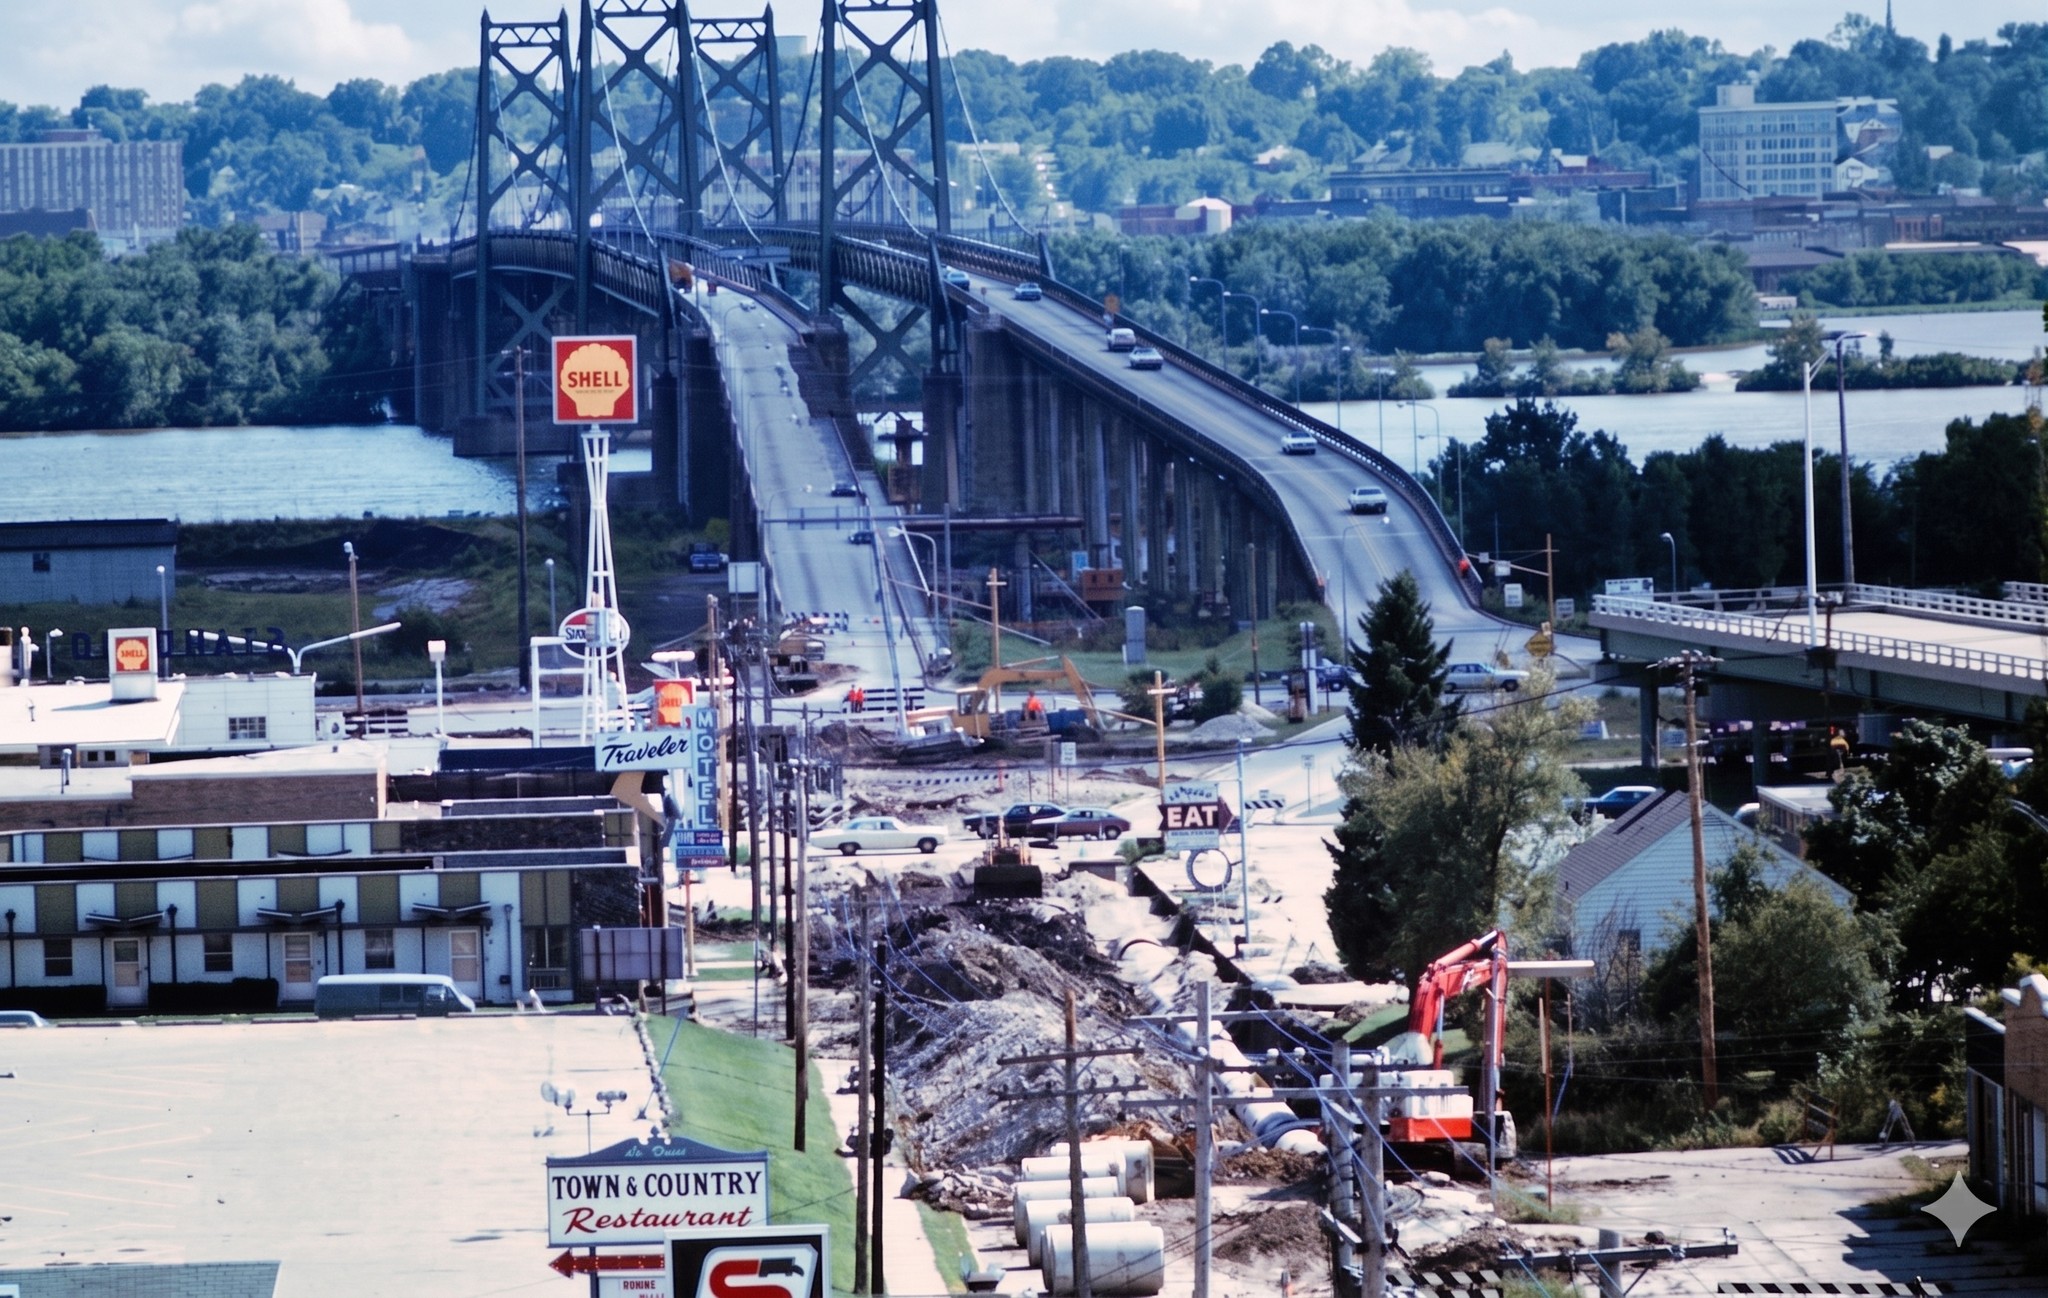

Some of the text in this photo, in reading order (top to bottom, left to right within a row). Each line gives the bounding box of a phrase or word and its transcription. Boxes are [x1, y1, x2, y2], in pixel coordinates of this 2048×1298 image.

[567, 371, 622, 388] SHELL
[602, 735, 690, 767] Traveler
[698, 711, 714, 823] MOTEL
[1167, 805, 1218, 828] EAT
[552, 1171, 762, 1200] TOWN & COUNTRY
[562, 1206, 754, 1235] Restaurant
